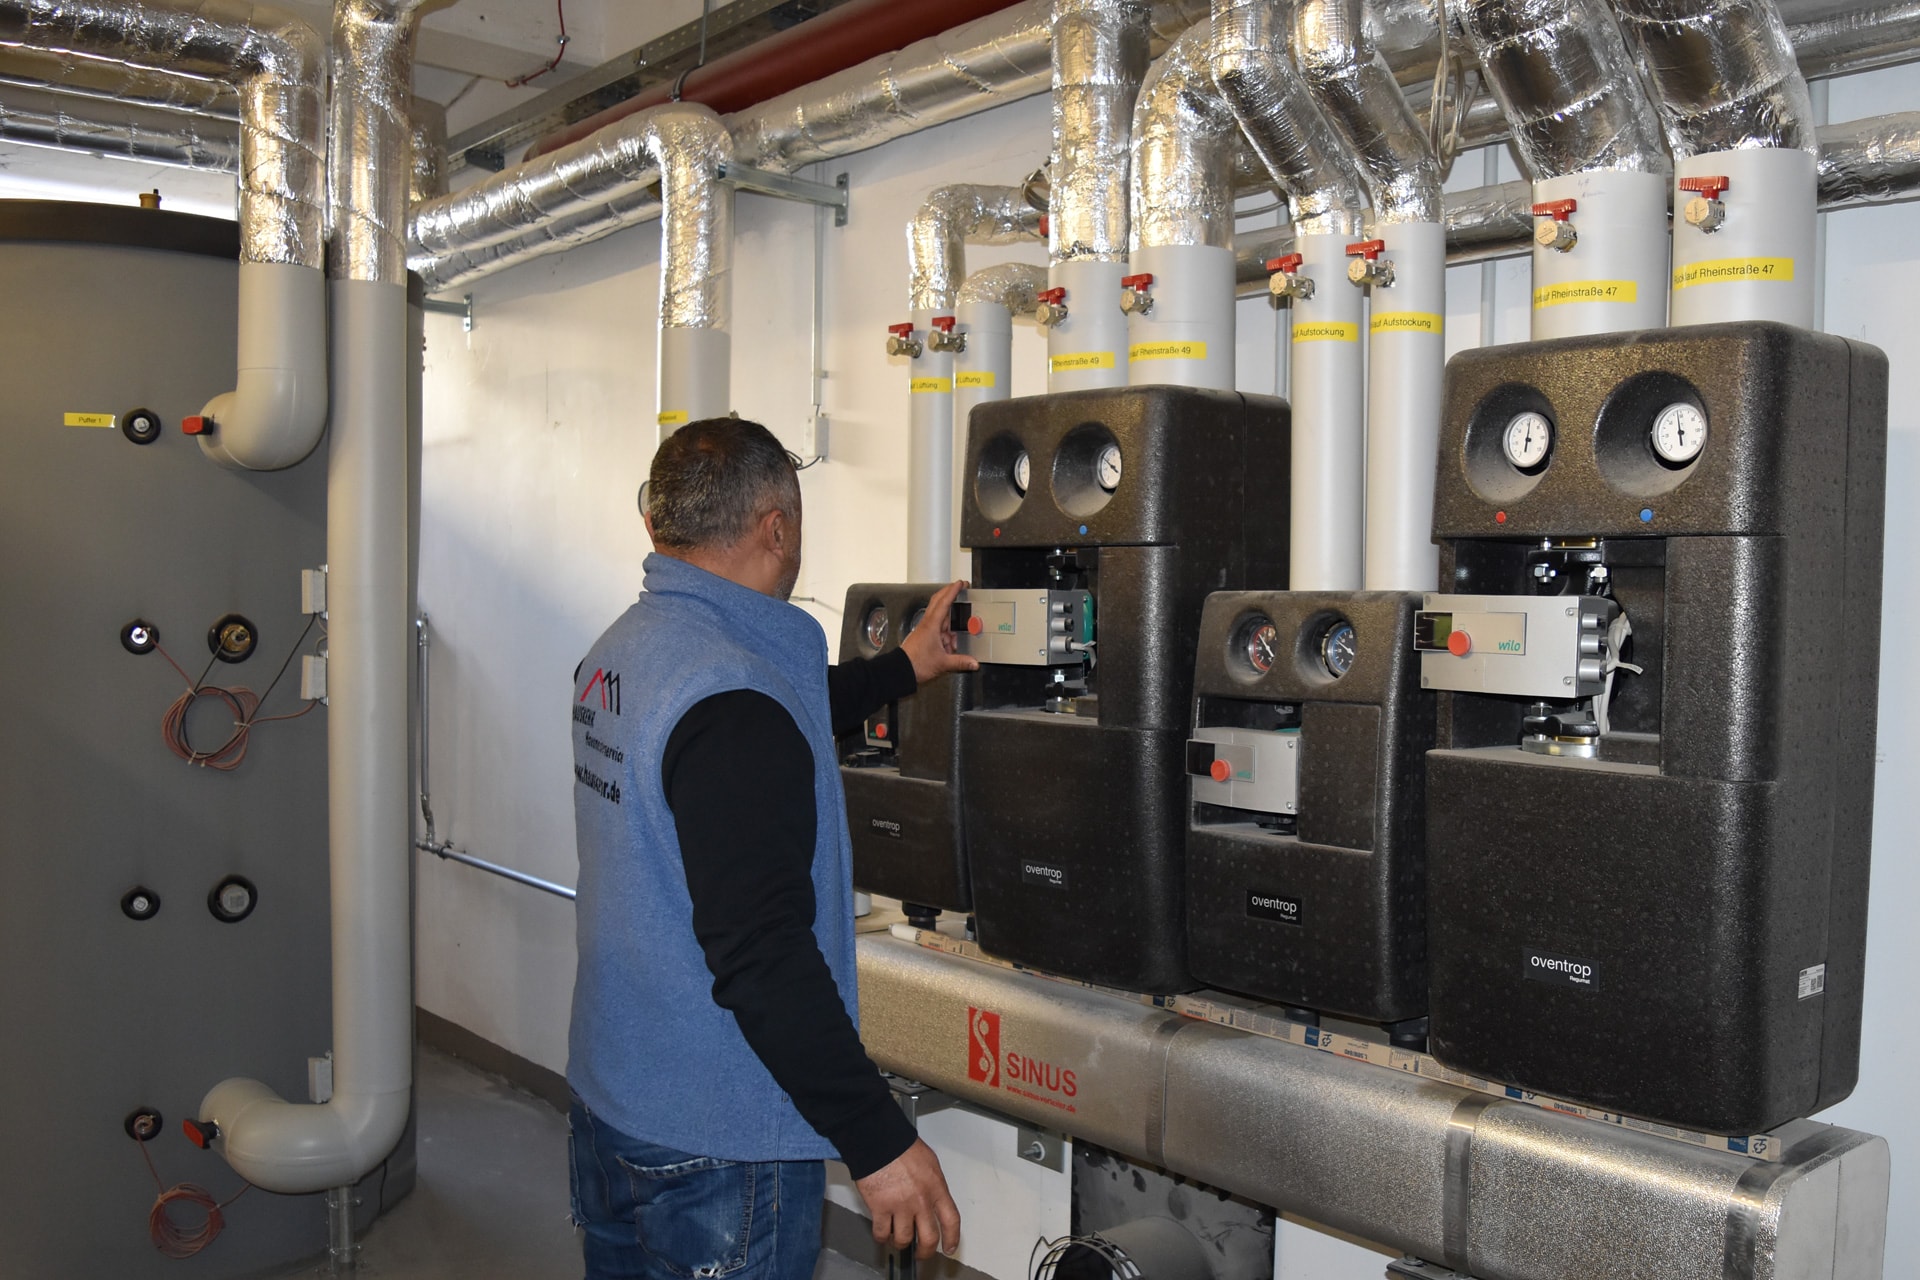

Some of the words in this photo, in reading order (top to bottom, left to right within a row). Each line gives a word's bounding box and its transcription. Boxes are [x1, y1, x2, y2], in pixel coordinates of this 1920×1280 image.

[1700, 264, 1760, 278] Rheinstraße
[1762, 264, 1775, 275] 47
[1551, 286, 1603, 299] Rheinstraße
[1605, 286, 1618, 297] 47
[1383, 318, 1432, 329] Aufstockung
[1299, 327, 1345, 337] Aufstockung
[1181, 346, 1192, 355] 49
[1090, 356, 1100, 365] 49
[1498, 639, 1521, 652] wilo
[1025, 864, 1062, 880] oventrop
[1251, 896, 1297, 915] oventrop
[1531, 955, 1592, 979] oventrop
[1006, 1052, 1077, 1097] SINUS
